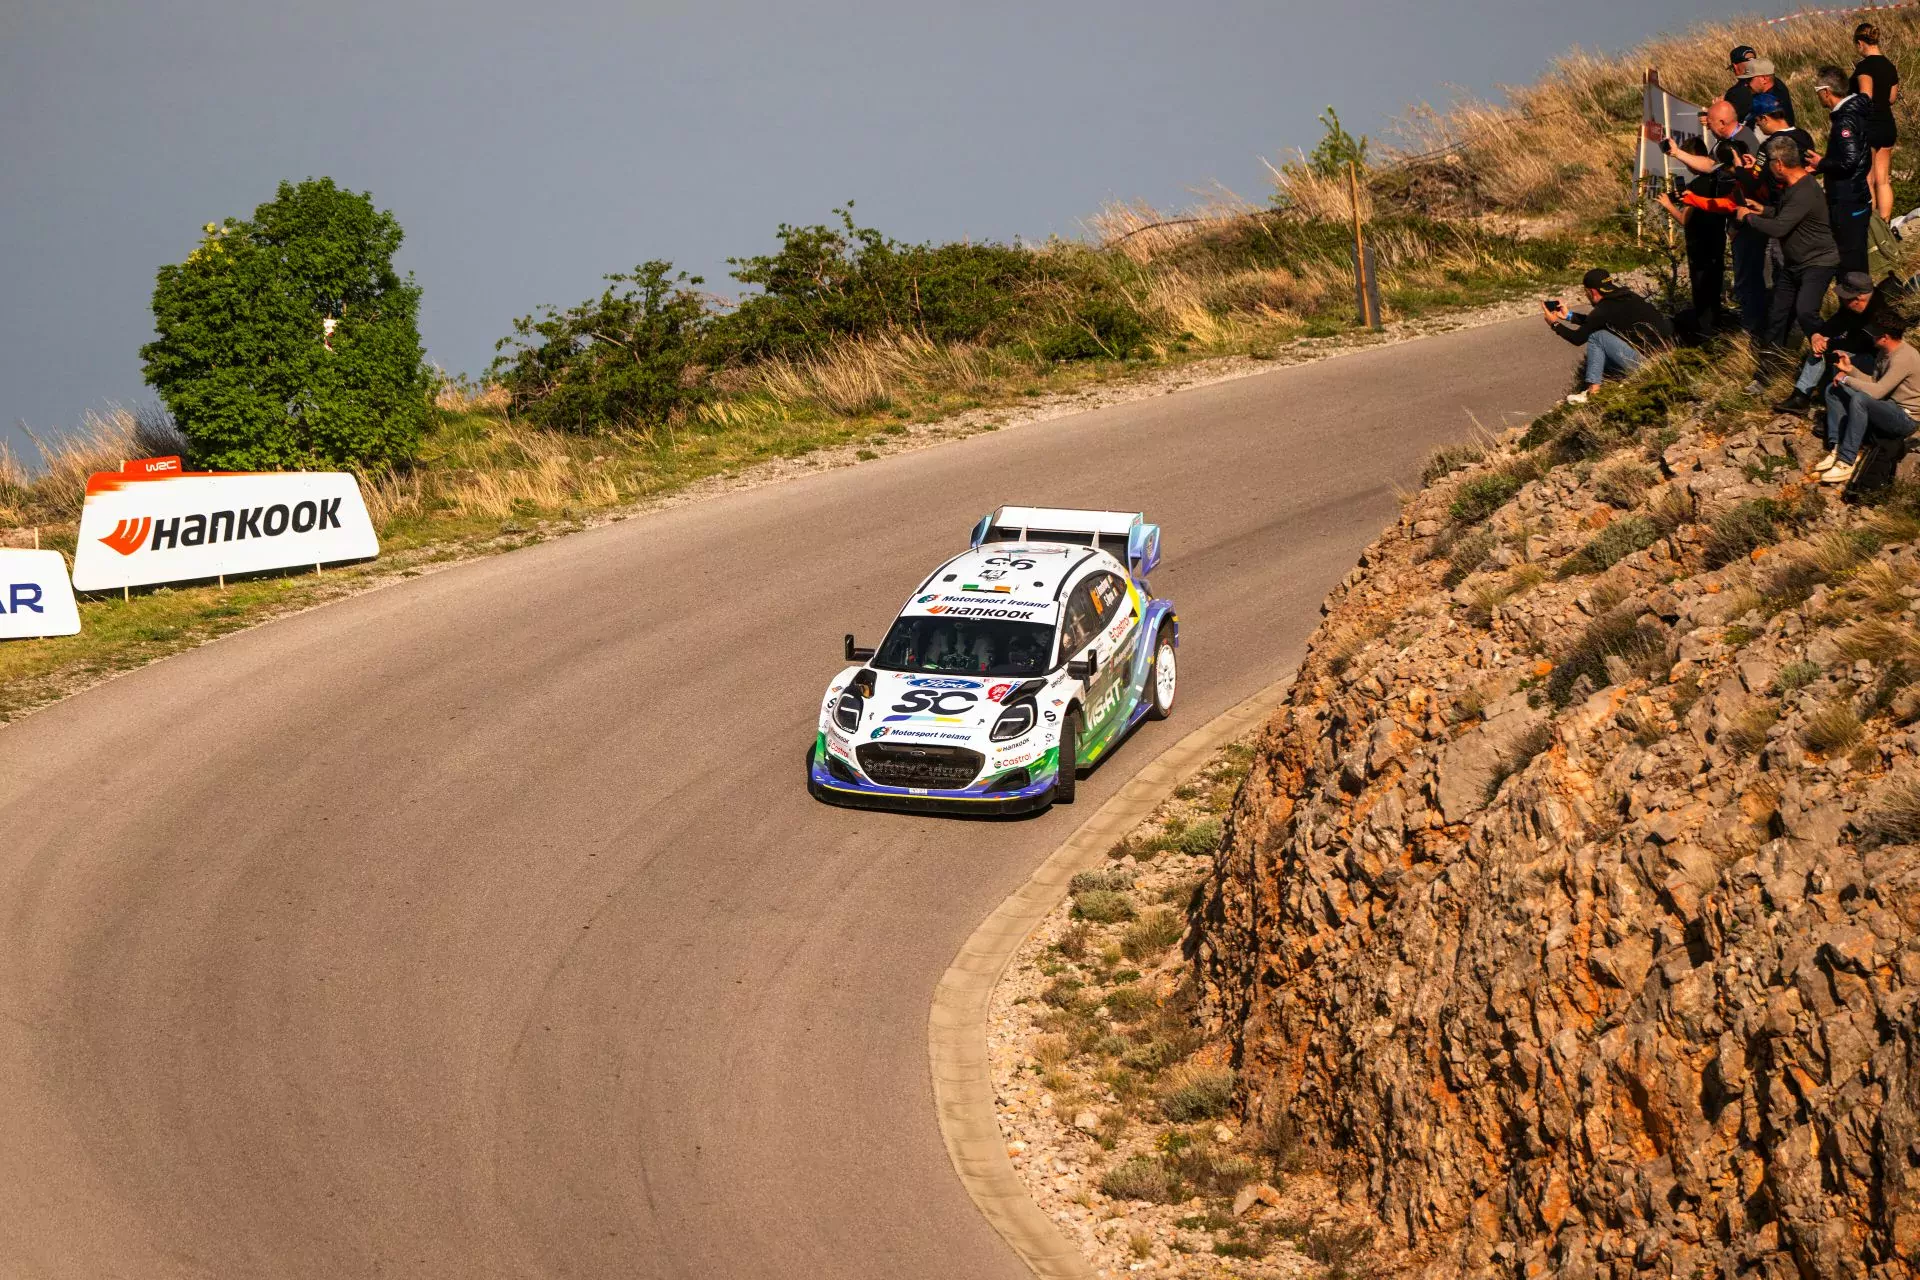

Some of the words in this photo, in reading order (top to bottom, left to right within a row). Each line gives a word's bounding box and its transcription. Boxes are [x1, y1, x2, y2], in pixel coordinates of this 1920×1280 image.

[145, 459, 178, 472] WRC
[941, 595, 1007, 605] Motorsport
[1007, 599, 1051, 609] Ireland
[919, 679, 972, 689] Ford
[891, 689, 979, 716] SC
[890, 729, 940, 738] Motorsport
[1003, 753, 1032, 767] Castrol
